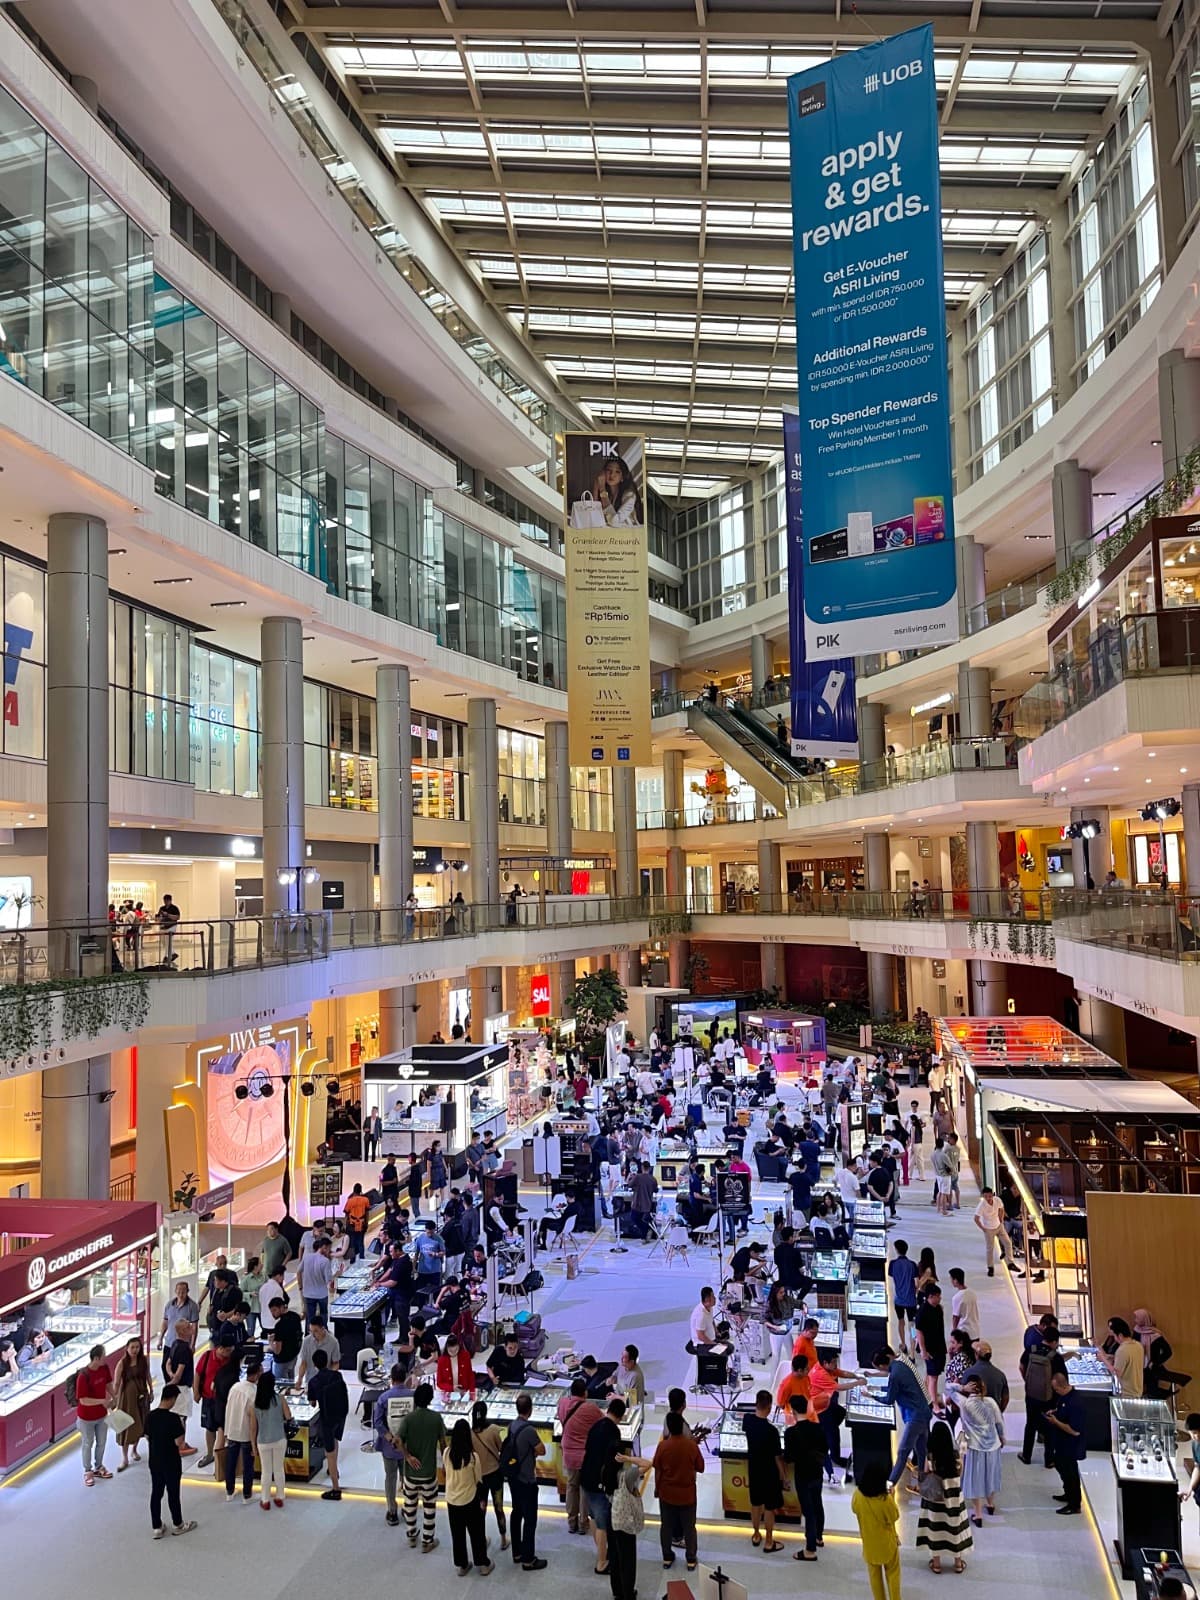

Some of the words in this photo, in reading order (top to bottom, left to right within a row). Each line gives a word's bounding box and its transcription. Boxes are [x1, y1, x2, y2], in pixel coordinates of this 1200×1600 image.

[882, 60, 923, 86] UOB
[821, 131, 903, 176] apply
[825, 182, 846, 210] &
[851, 162, 902, 206] get
[802, 193, 930, 251] rewards.
[823, 266, 845, 284] Get
[846, 249, 909, 278] E-Voucher
[832, 277, 862, 298] ASRI
[863, 268, 900, 290] Living
[811, 306, 826, 318] with
[842, 293, 866, 312] spend
[866, 291, 874, 302] of
[874, 286, 890, 301] IDR
[833, 314, 842, 323] or
[842, 307, 857, 321] IDR
[813, 338, 872, 365] Additional
[873, 325, 928, 349] Rewards
[849, 354, 889, 370] E-Voucher
[889, 347, 910, 359] ASRI
[910, 342, 935, 355] Living
[810, 383, 820, 393] by
[820, 375, 854, 391] spending
[870, 365, 885, 377] IDR
[808, 417, 830, 431] Top
[831, 405, 882, 427] Spender
[883, 391, 939, 413] Rewards
[818, 444, 835, 455] Free
[835, 436, 864, 451] Parking
[863, 431, 896, 444] Member
[902, 423, 929, 435] month
[828, 429, 843, 441] Win
[843, 424, 863, 436] Hotel
[863, 416, 900, 432] Vouchers
[900, 413, 916, 424] and
[589, 441, 619, 457] PIK
[572, 536, 606, 546] Grandeur
[609, 536, 641, 545] Rewards
[590, 612, 629, 625] Rp15mio
[816, 633, 840, 649] PIK
[894, 622, 946, 636] asriliving.com
[596, 689, 622, 700] JWX
[227, 1027, 257, 1054] JWX
[48, 1246, 87, 1274] GOLDEN
[87, 1233, 114, 1255] EIFFEL
